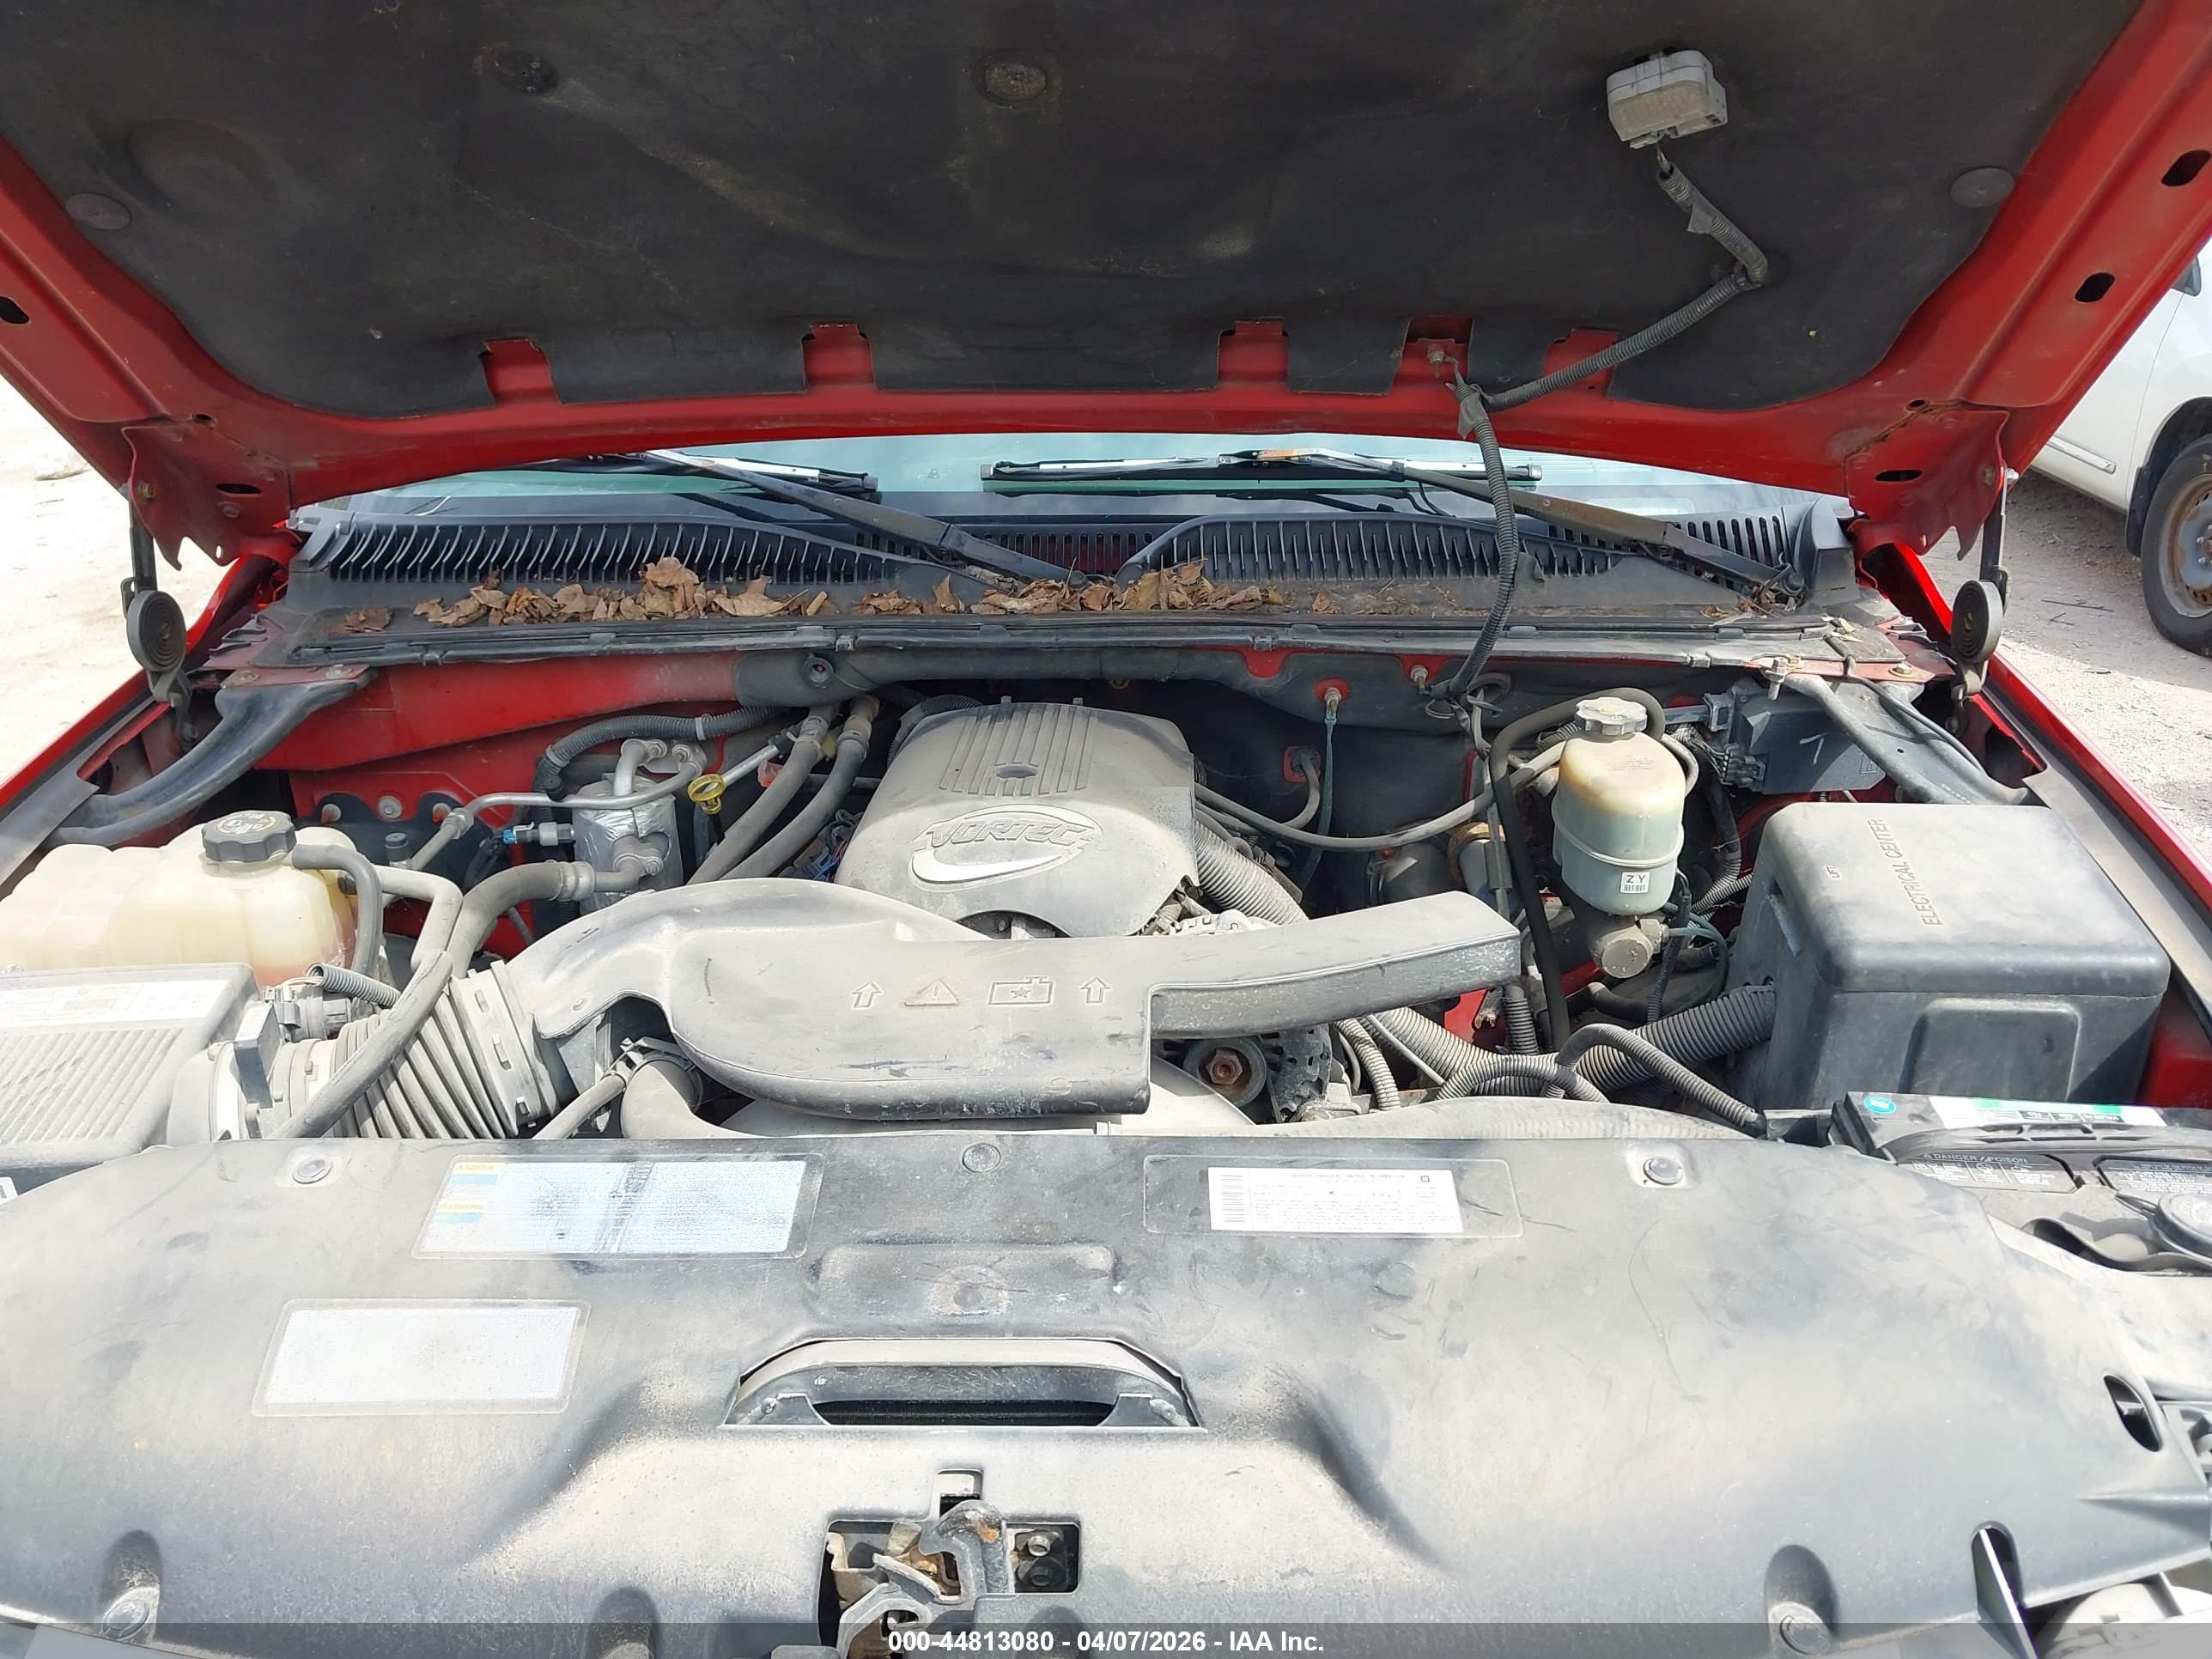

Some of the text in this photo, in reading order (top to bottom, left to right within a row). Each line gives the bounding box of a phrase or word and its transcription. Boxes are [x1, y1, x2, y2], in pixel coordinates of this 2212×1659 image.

[926, 818, 1087, 848] VORTEC
[1867, 818, 1904, 859] CENTER
[1826, 866, 1841, 878] LIFT
[1892, 861, 1943, 926] ELECTRICAL
[1933, 1153, 1978, 1162] DANGER
